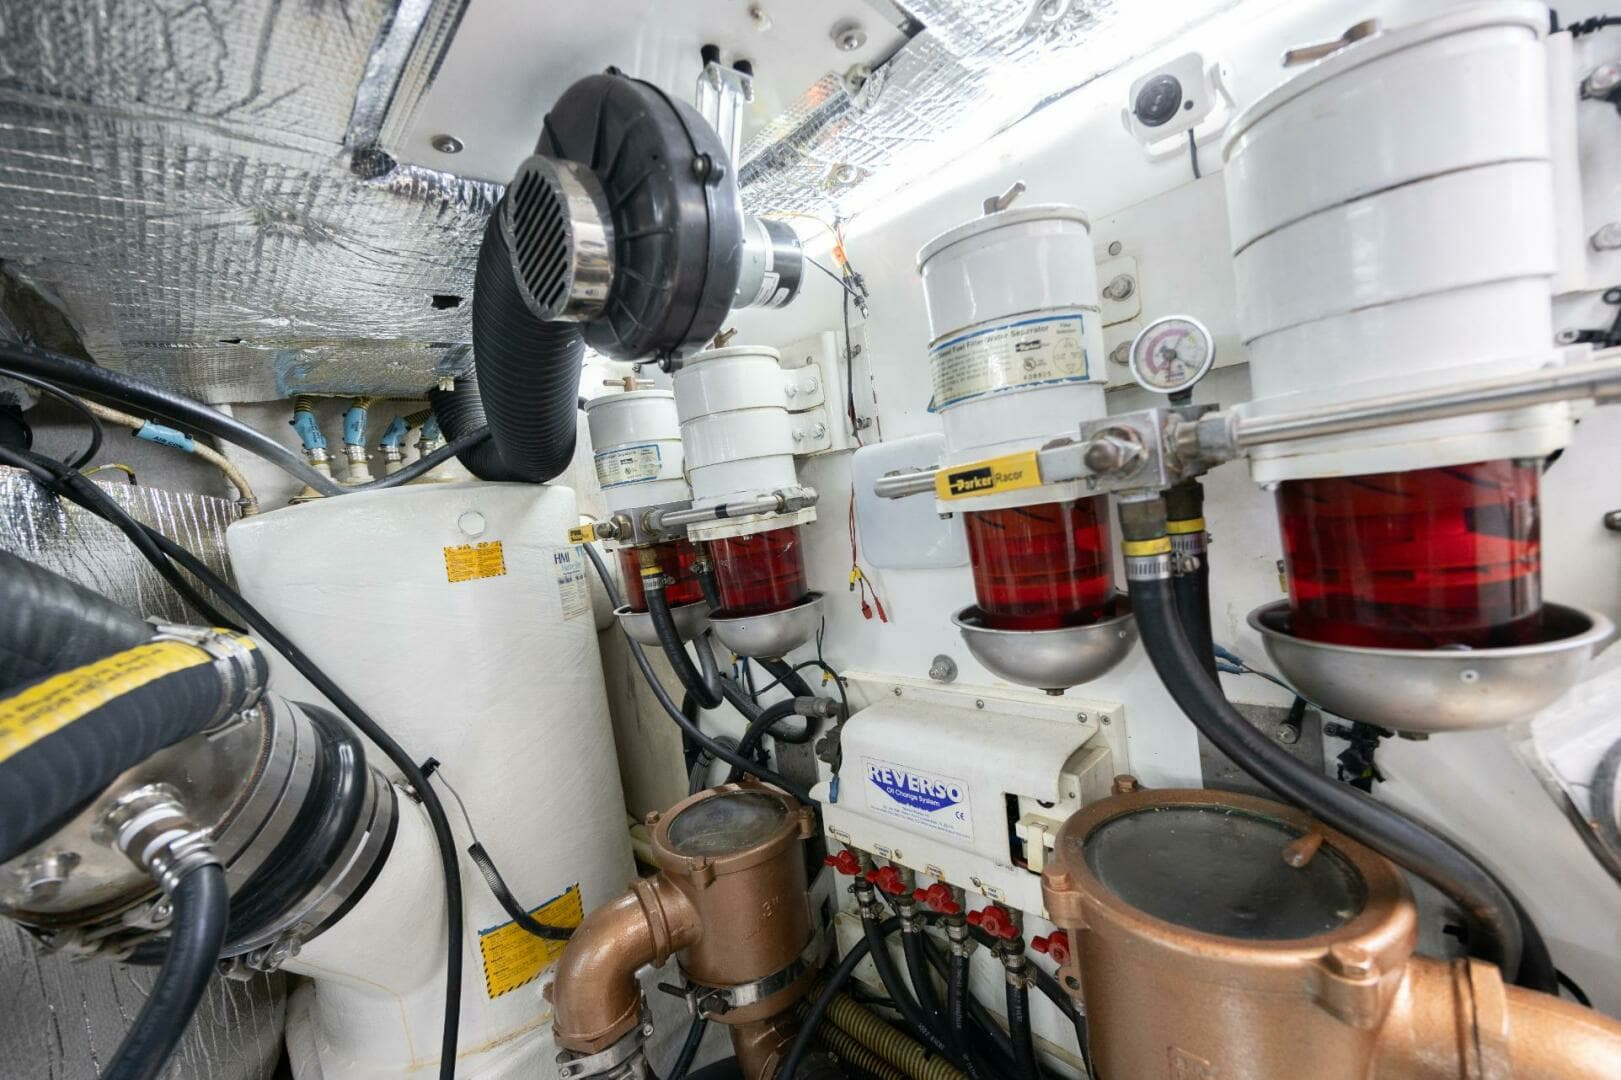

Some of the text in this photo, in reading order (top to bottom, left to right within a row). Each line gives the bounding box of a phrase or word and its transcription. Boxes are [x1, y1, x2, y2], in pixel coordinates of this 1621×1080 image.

[1010, 325, 1050, 338] Separator
[953, 470, 1023, 492] Parker Racor
[867, 763, 964, 803] REVERSO
[895, 788, 918, 802] Change
[918, 796, 941, 807] System
